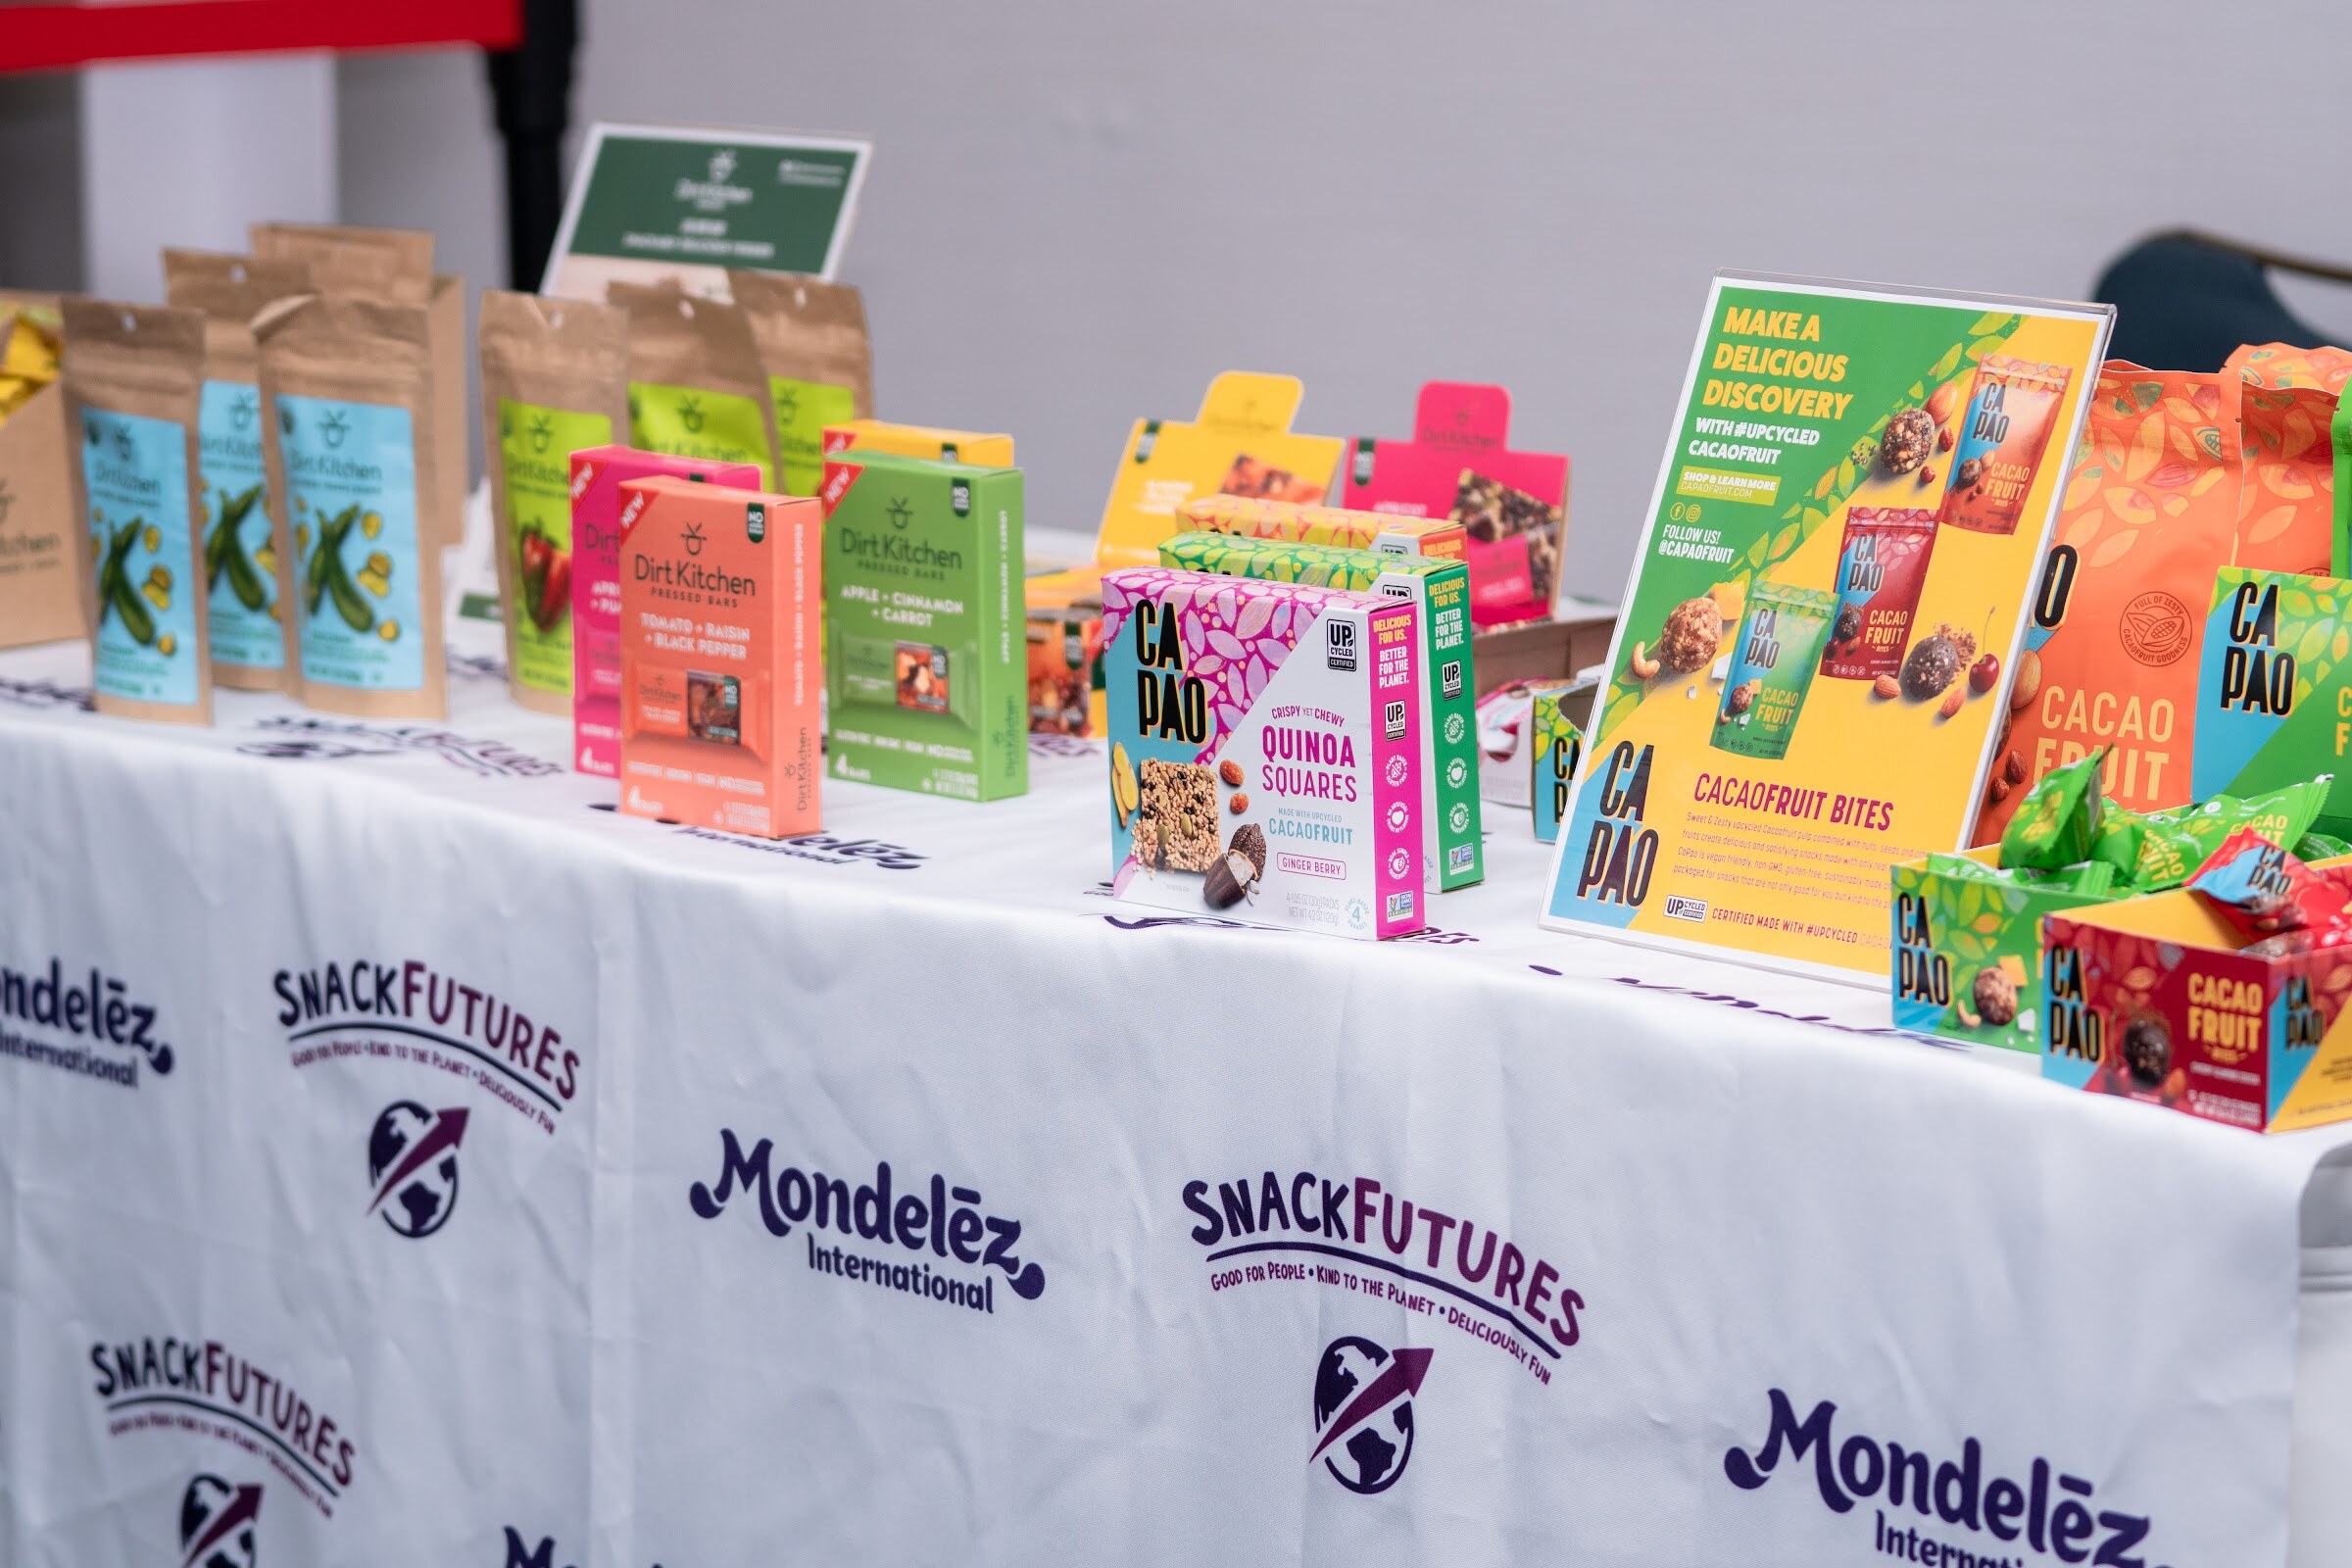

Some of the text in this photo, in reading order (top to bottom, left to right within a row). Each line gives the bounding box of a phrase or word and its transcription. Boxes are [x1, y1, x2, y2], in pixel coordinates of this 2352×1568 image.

[1723, 307, 1820, 342] MAKE A
[1712, 342, 1849, 383] DELICIOUS
[1702, 378, 1854, 421] DISCOVERY
[1982, 382, 2007, 414] CA
[1695, 416, 1821, 446] WITH #UPCYCLED
[1972, 411, 2010, 444] PAO
[1688, 440, 1782, 466] CACAOFRUIT
[1684, 470, 1778, 491] SHOP LEARN MORE
[1989, 462, 2031, 483] CACAO
[1681, 481, 1753, 499] CAPAOFRUIT.COM
[1984, 478, 2027, 502] FRUIT
[620, 490, 644, 529] NEW
[747, 511, 764, 523] NO
[840, 526, 962, 570] Dirt Kitchen
[1663, 523, 1722, 545] FOLLOW US!
[1853, 534, 1879, 563] CA
[1658, 539, 1735, 564] @CAPAOFRUIT
[634, 554, 757, 597] Dirt Kitchen
[1428, 577, 1465, 596] DELICIOUS
[1846, 563, 1886, 592] PAO
[651, 586, 739, 609] PRESSED BARS
[840, 584, 964, 614] APPLE CINNAMON
[1434, 591, 1461, 608] FOR US.
[2133, 595, 2184, 615] FULL OF ZESTY
[640, 612, 751, 643] TOMATO RAISIN
[881, 607, 934, 627] CARROT
[1373, 613, 1412, 633] DELICIOUS
[1435, 608, 1462, 624] BETTER
[1435, 620, 1463, 638] FOR THE
[1753, 608, 1778, 639] CA
[1868, 609, 1909, 628] CACAO
[2229, 581, 2278, 649] CA
[654, 632, 748, 660] BLACK PEPPER
[1135, 599, 1187, 673] CA
[1330, 623, 1352, 648] UP
[1378, 628, 1407, 646] FOR US.
[1435, 633, 1464, 651] PLANET.
[1864, 626, 1905, 645] FRUIT
[2123, 628, 2188, 663] CACAOFRUIT GOODNESS
[1330, 647, 1353, 658] CYCLED
[1330, 659, 1354, 669] CERTIFIED
[1379, 646, 1407, 662] BETTER
[1379, 658, 1409, 676] FOR THE
[1743, 638, 1782, 669] PAO
[1379, 672, 1410, 689] PLANET.
[1444, 663, 1459, 683] UP
[2220, 644, 2298, 719] PAO
[1137, 668, 1209, 746] PAO
[1761, 686, 1799, 707] CACAO
[1271, 705, 1346, 728] CRISPY YET CHEWY
[1387, 704, 1403, 723] UP
[1754, 704, 1795, 725] FRUIT
[2041, 685, 2176, 744] CACAO
[798, 727, 808, 781] Kitchen
[1261, 724, 1356, 769] QUINOA
[1261, 764, 1357, 804] SQUARES
[1598, 740, 1655, 822] CA
[1278, 807, 1343, 823] MADE WITH UPCYCLED
[1692, 772, 1895, 833] CACAOFRUIT BITES
[1268, 817, 1353, 846] CACAOFRUIT
[1682, 828, 1842, 864] fruits create delicious and satisfying snacks made
[1687, 812, 1899, 856] Sweet Zesty upcycled combined with seeds
[1282, 858, 1342, 876] GINGER BERRY
[1576, 819, 1660, 908] PAO
[1706, 853, 1726, 864] vegan
[1717, 871, 1740, 884] snacks
[1351, 906, 1361, 922] 4
[1666, 898, 1706, 915] UP CYCLED
[1898, 892, 1934, 949] CA
[1712, 907, 1859, 945] CERTIFIED MADE WITH #UPCYCLED
[1898, 947, 1954, 1007] PAO
[2050, 944, 2088, 1005] CA
[2187, 972, 2264, 1016] CACAO
[0, 956, 174, 1074] ndelēz
[2186, 1004, 2263, 1054] FRUIT
[2050, 998, 2106, 1063] PAO
[395, 1044, 409, 1059] TO
[411, 1047, 429, 1065] THE
[431, 1050, 471, 1079] PLANET
[477, 1069, 538, 1120] DELICIOUSLY
[689, 1128, 1046, 1300] Mondelēz
[807, 1232, 996, 1314] International
[1210, 1260, 1551, 1386] GOOD FOR PEOPLE KIND TO THE PLANET DELICIOUSLY FUN
[1724, 1388, 2177, 1568] Mondelēz
